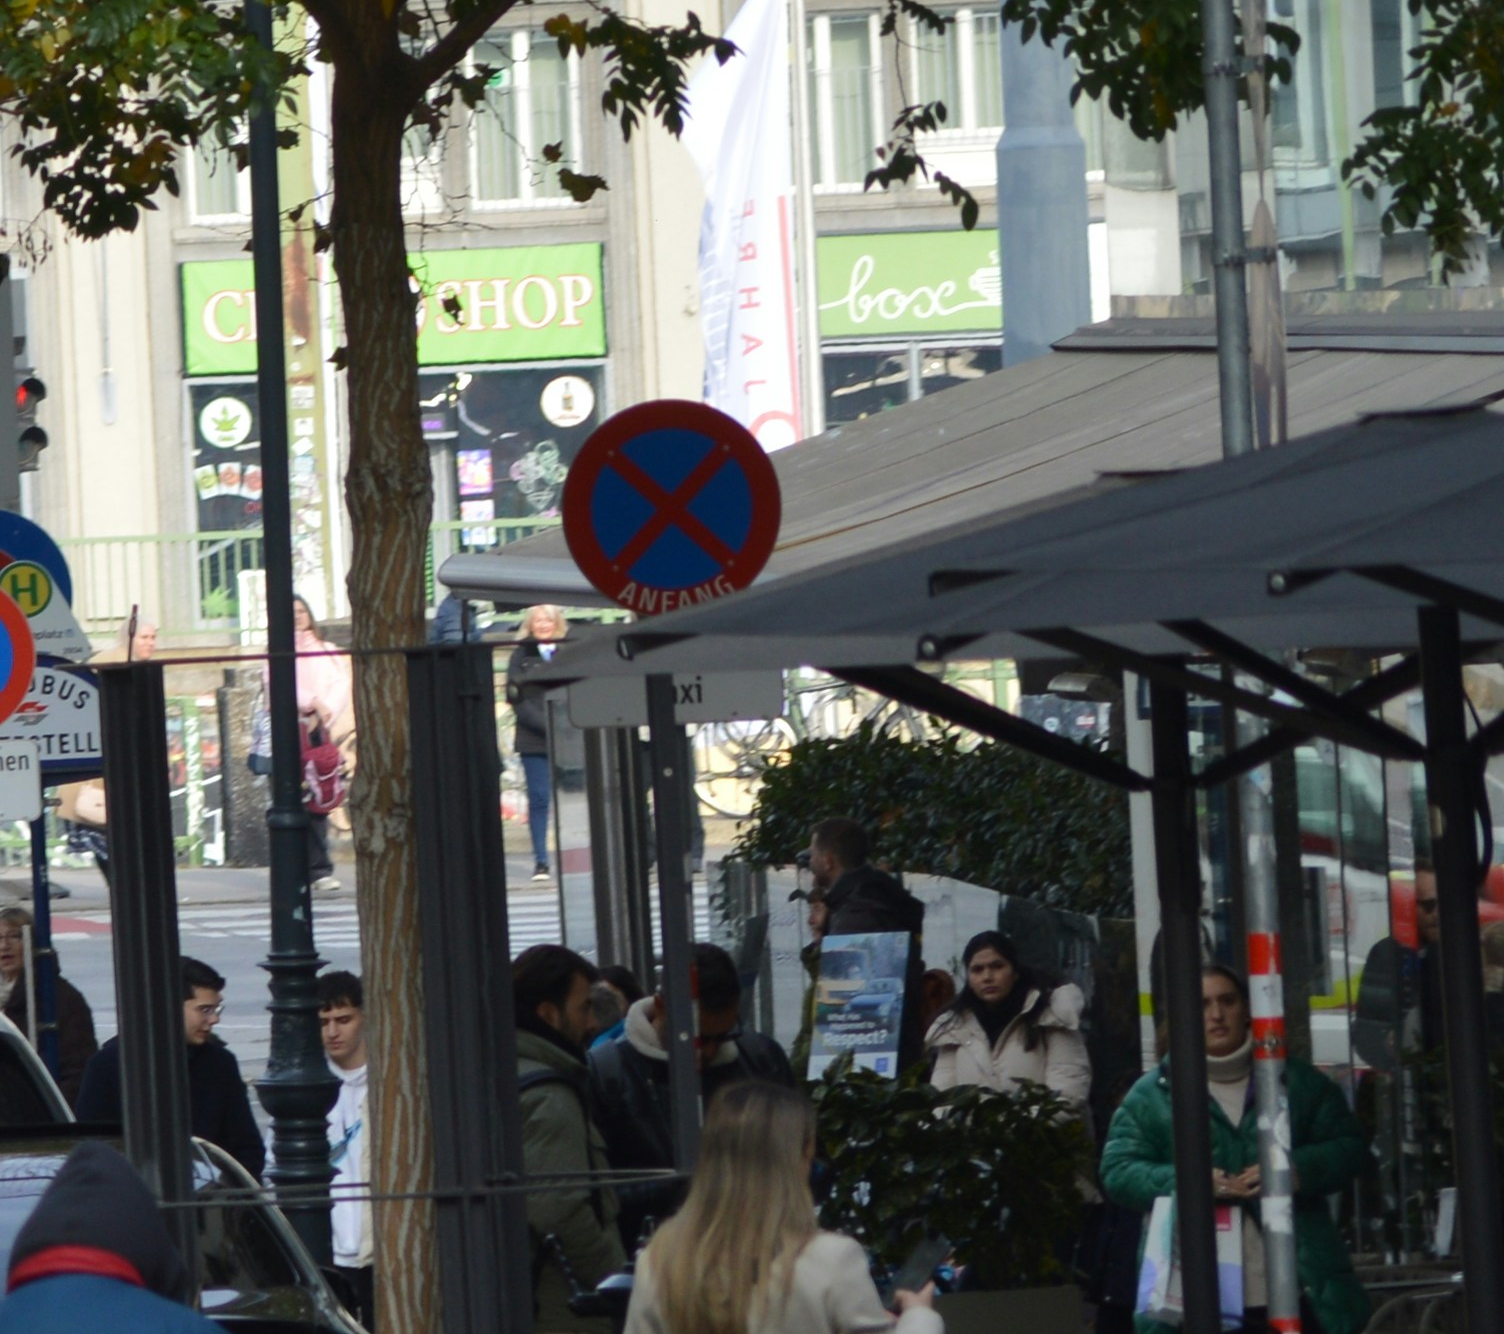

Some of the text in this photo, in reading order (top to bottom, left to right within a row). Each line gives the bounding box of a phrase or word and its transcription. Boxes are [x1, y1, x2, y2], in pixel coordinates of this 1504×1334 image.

[436, 274, 594, 332] SHOP
[9, 572, 39, 608] H
[823, 1029, 888, 1048] Respect?
